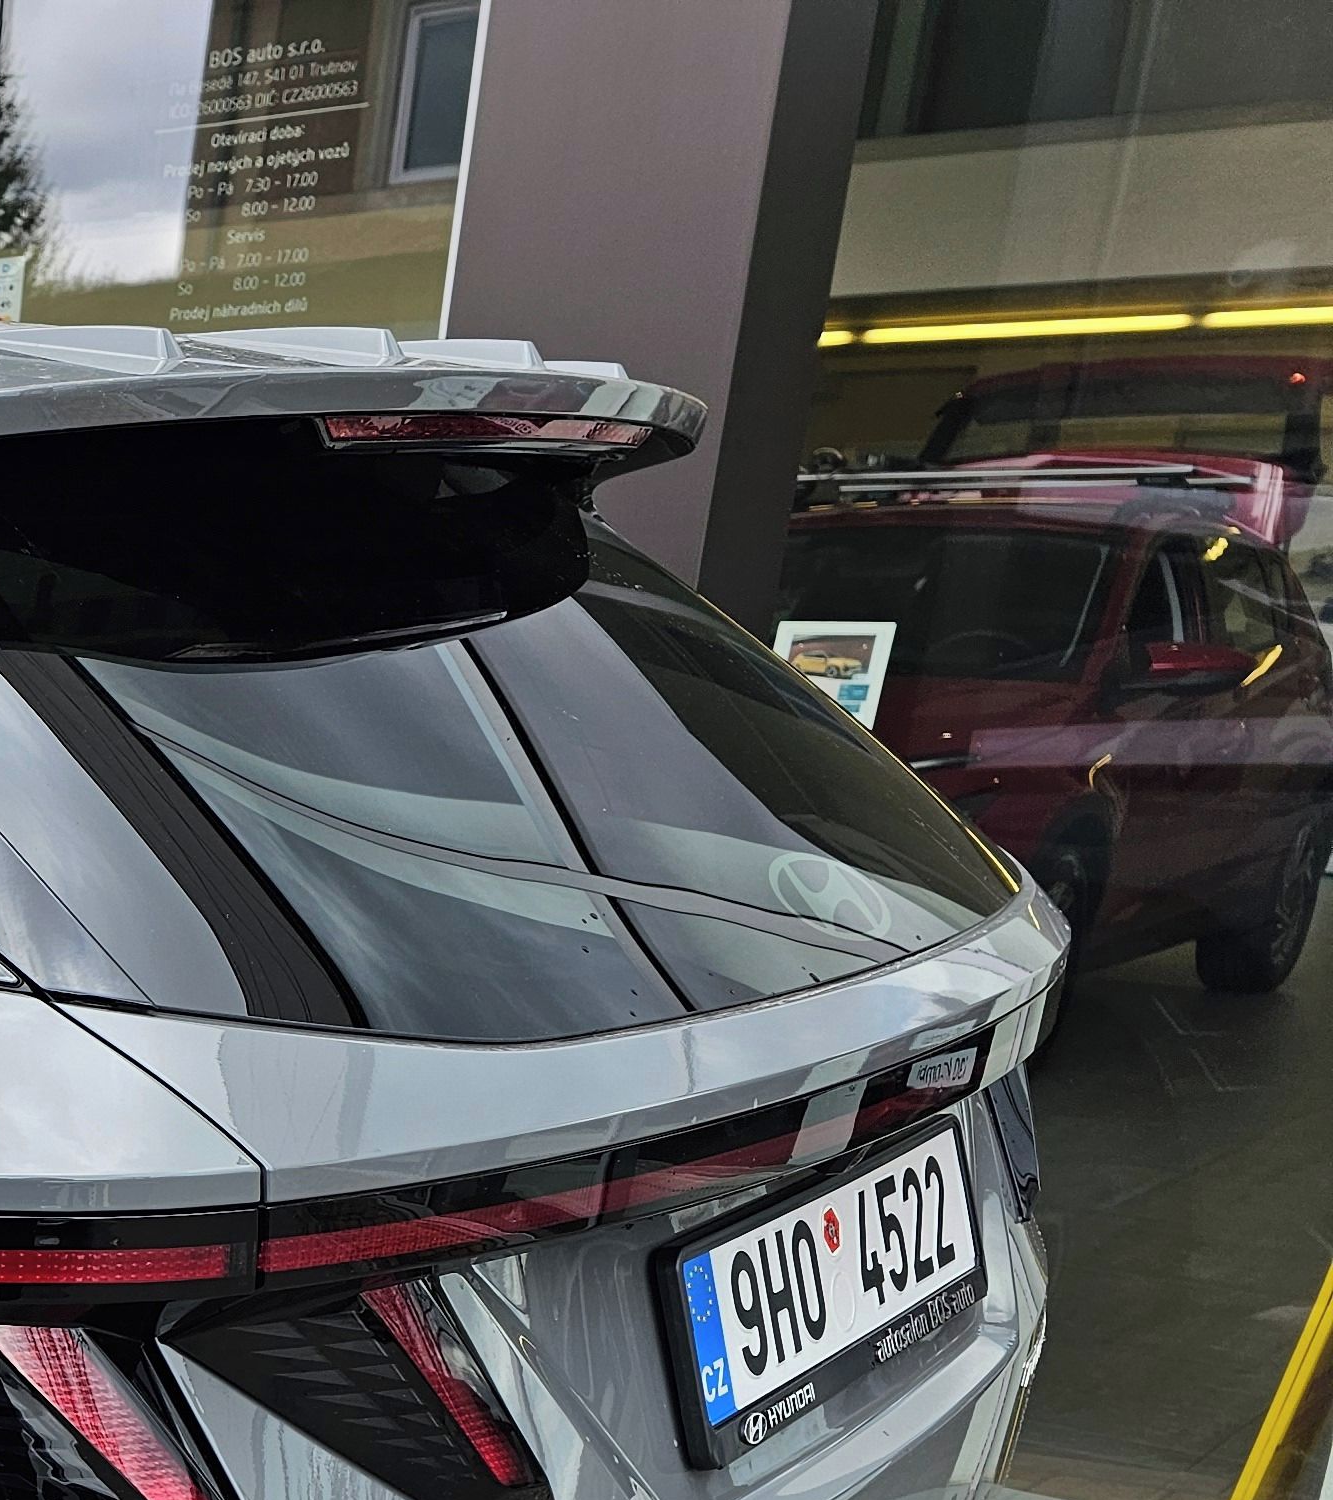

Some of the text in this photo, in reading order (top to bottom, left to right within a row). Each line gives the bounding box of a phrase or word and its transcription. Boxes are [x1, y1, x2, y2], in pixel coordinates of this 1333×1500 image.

[208, 38, 326, 68] BOS auto s.r.o.
[264, 66, 286, 85] 541
[289, 63, 305, 81] 01
[309, 59, 359, 78] Trutnov
[269, 123, 307, 141] doba:
[254, 156, 264, 169] a
[187, 184, 205, 199] Po
[286, 171, 319, 189] 17.00
[185, 208, 202, 223] So
[226, 227, 267, 245] Servis
[277, 247, 310, 264] 17.00
[177, 281, 194, 296] So
[274, 271, 306, 288] 12.00
[169, 307, 211, 323] Prodej
[730, 1154, 957, 1377] 9H0 4522
[875, 1281, 976, 1364] autosalon BOS auto
[701, 1357, 730, 1404] CZ
[769, 1382, 817, 1428] HYUNDAI
